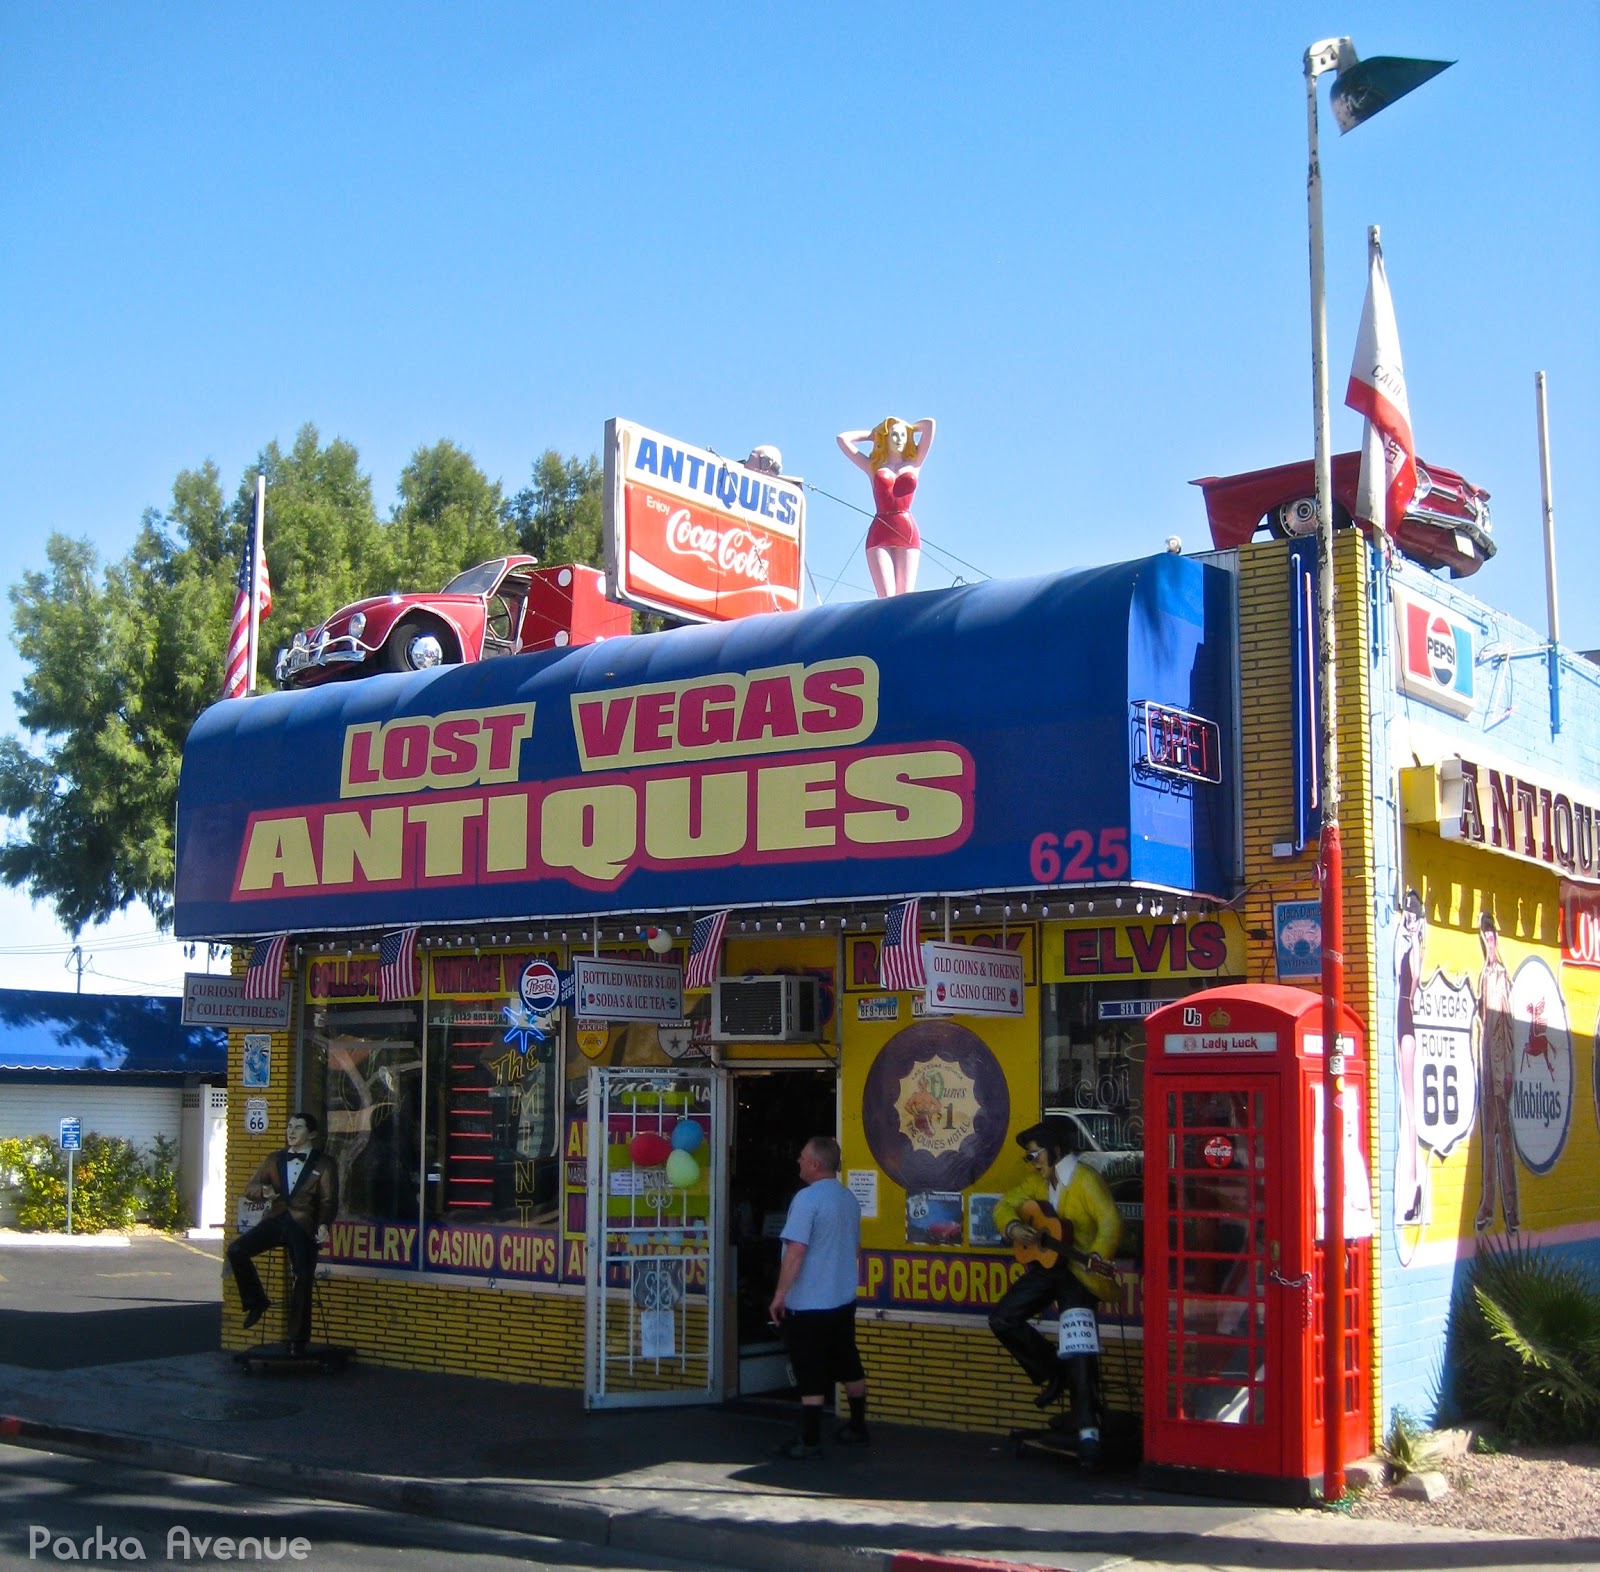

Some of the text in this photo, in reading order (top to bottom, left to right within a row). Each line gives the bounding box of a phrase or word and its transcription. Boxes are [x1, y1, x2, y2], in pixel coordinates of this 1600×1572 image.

[635, 437, 798, 526] ANTIQUES
[646, 495, 671, 516] Enjoy
[1427, 634, 1456, 668] PEPSI
[346, 664, 870, 787] LOST VEGAS
[238, 750, 963, 890] ANTIQUES
[1459, 758, 1600, 880] ANTIQU
[1029, 827, 1129, 883] 625
[1064, 921, 1228, 976] ELVIS
[583, 970, 677, 990] BOTTLED WATER $1.00
[934, 956, 1020, 980] OLD COINS & TOKENS
[561, 974, 575, 991] SOLD
[561, 984, 575, 1002] HERE
[950, 982, 1006, 1002] CASINO CHIPS
[197, 1002, 279, 1019] COLLECTIBLES
[596, 992, 666, 1011] SODAS & ICE TEA
[1120, 1003, 1134, 1015] SEX
[1413, 993, 1468, 1020] LAS VEGAS
[1202, 1036, 1258, 1051] Lady Luck
[1421, 1033, 1456, 1059] ROUTE
[1422, 1063, 1459, 1127] 66
[1513, 1080, 1562, 1128] Mobilgas
[249, 1116, 265, 1130] 66
[942, 1102, 956, 1130] 1
[906, 1120, 972, 1150] THE DUNES HOTEL
[912, 1207, 927, 1218] 66
[319, 1224, 417, 1262] WELRY
[428, 1228, 495, 1270] CASINO
[500, 1234, 556, 1275] CHIPS
[1062, 1320, 1095, 1330] WATER
